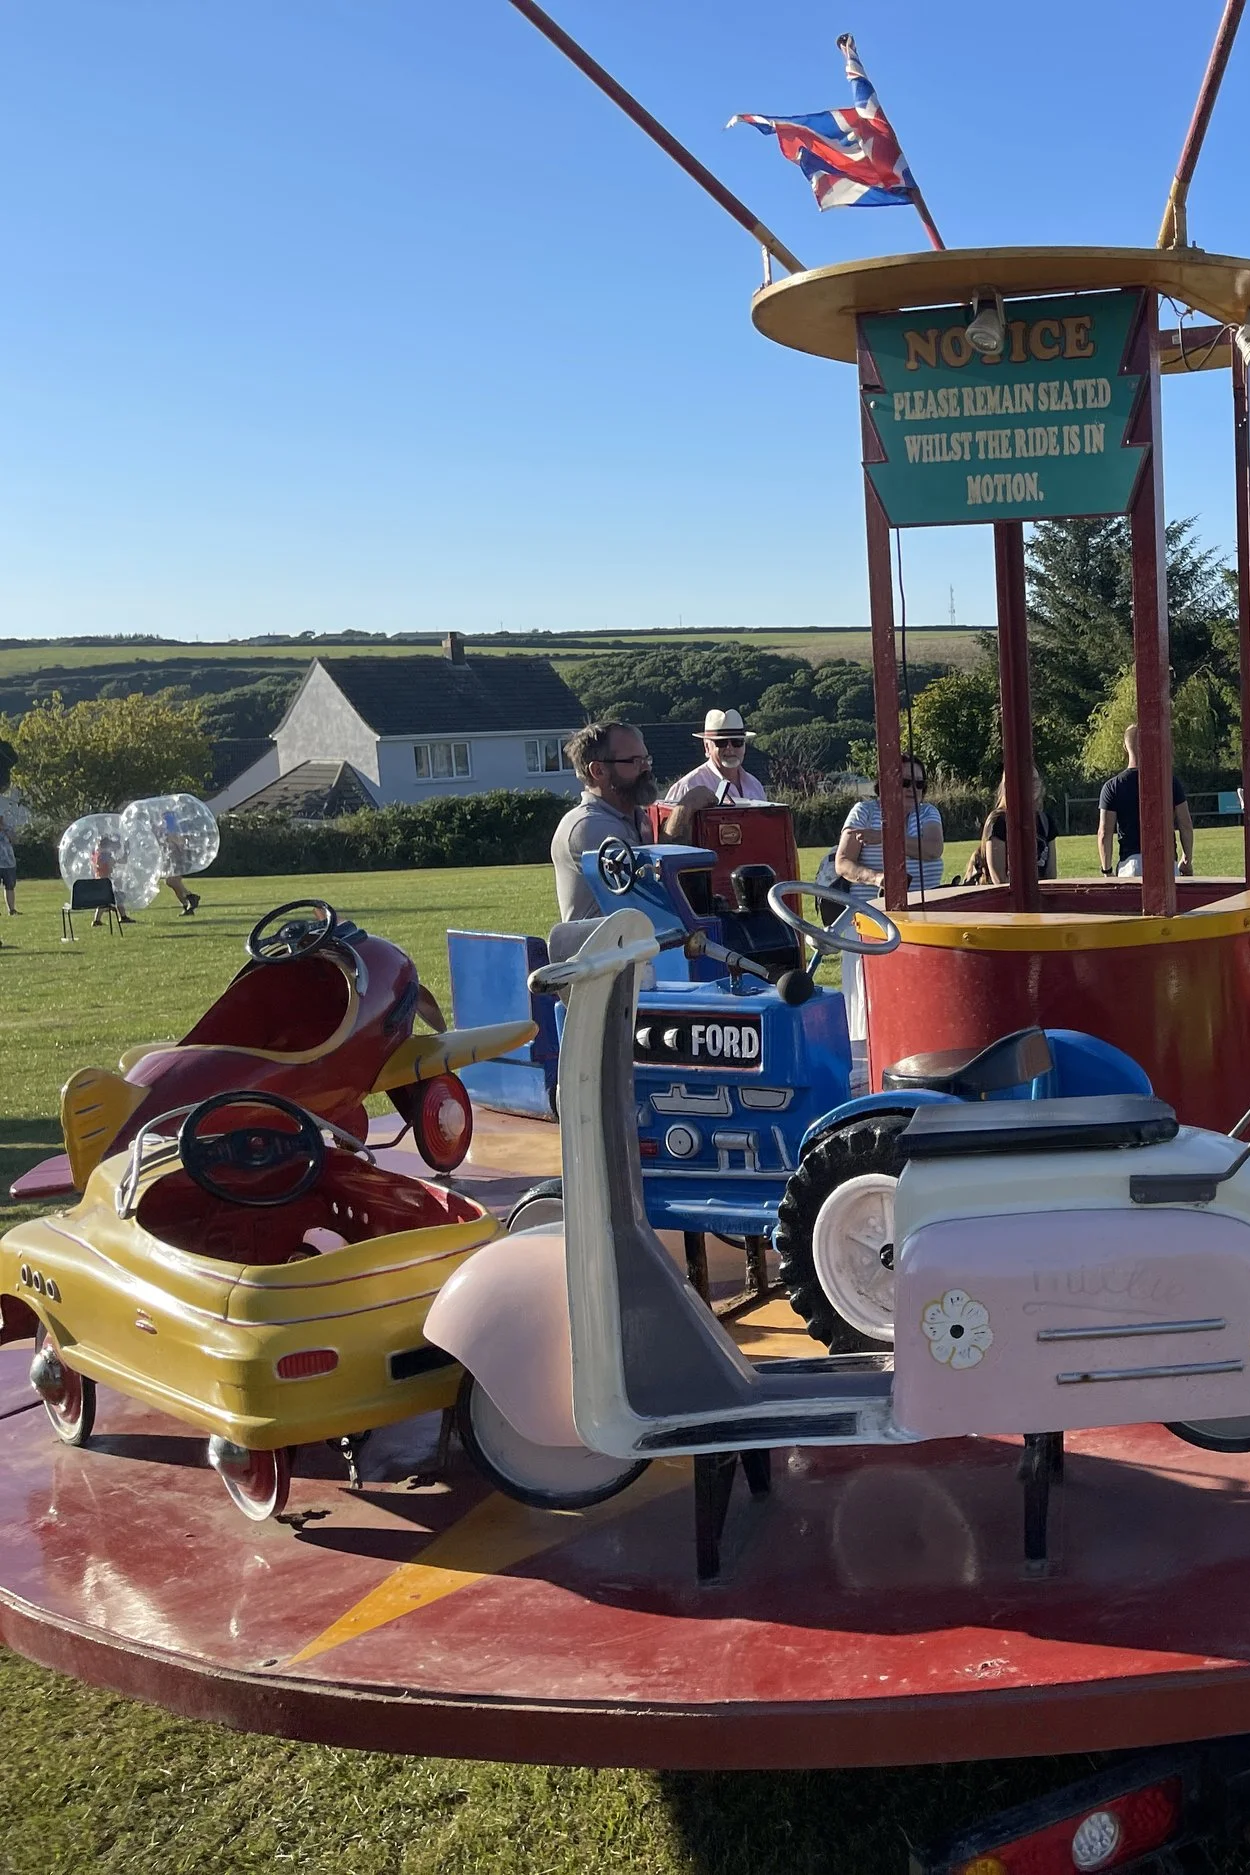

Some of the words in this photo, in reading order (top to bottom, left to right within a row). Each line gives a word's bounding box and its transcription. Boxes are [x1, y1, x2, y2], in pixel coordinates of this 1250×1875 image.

[893, 388, 960, 421] PLEASE
[963, 383, 1035, 416] REMAIN
[1037, 377, 1111, 410] SEATED
[904, 432, 973, 463] WHILST
[975, 430, 1013, 459] THE
[1013, 427, 1060, 456] RIDE
[1062, 425, 1081, 455] IS
[1083, 423, 1105, 453] IN
[966, 472, 1044, 505] MOTION.
[691, 1024, 759, 1059] FORD
